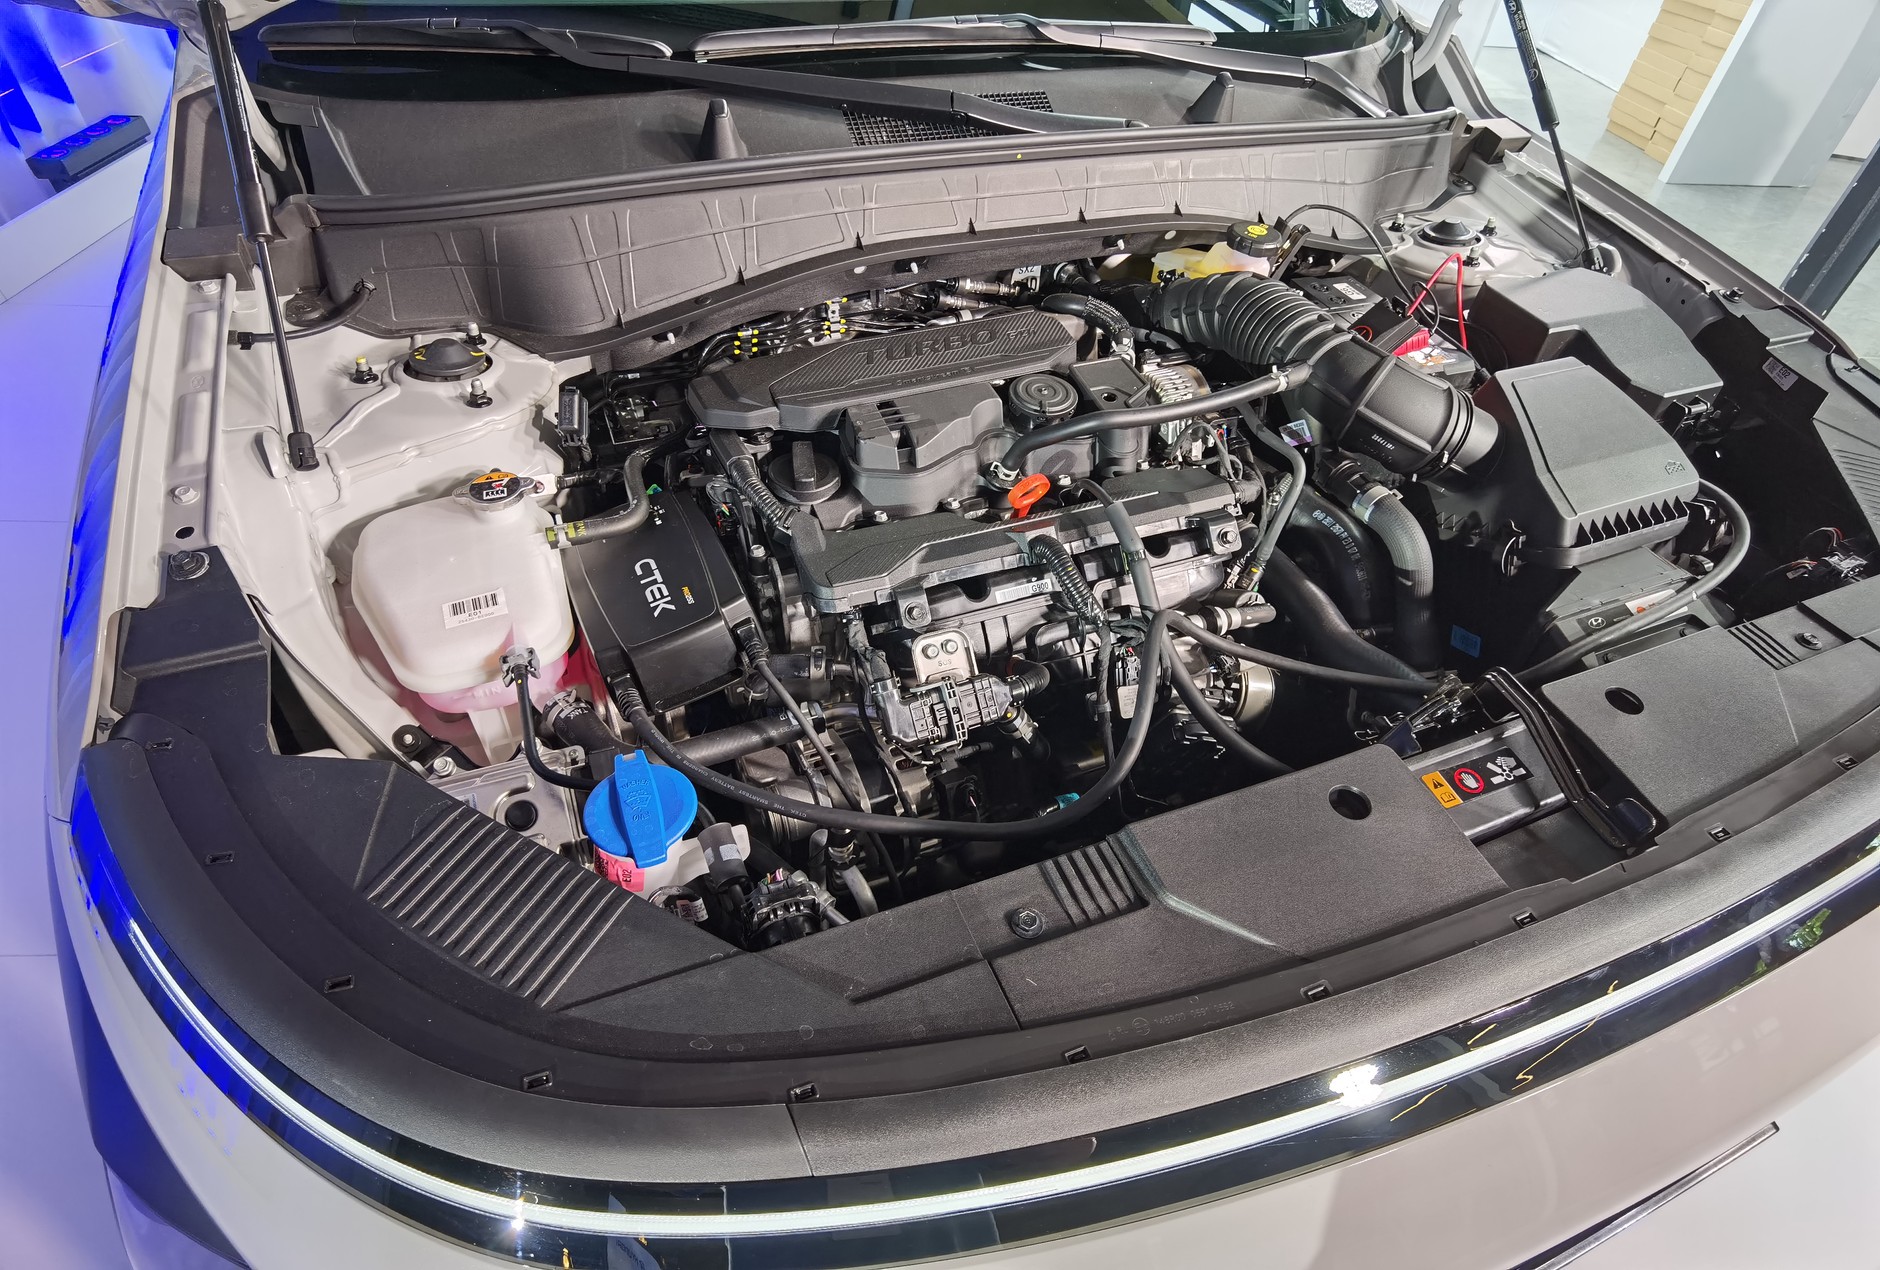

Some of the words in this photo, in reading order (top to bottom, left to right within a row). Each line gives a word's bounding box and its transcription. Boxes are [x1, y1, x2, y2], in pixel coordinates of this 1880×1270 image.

[857, 329, 998, 365] TURBO
[1779, 366, 1791, 379] E02
[634, 558, 676, 618] CTEK
[1031, 582, 1049, 593] G900
[567, 708, 589, 720] TANK
[683, 760, 709, 777] CHARGERS
[621, 779, 649, 791] WASHER
[711, 776, 735, 791] BATTERY
[738, 789, 769, 805] SMARTEST
[773, 802, 786, 811] THE
[790, 809, 807, 818] CTEK
[621, 868, 632, 883] E02
